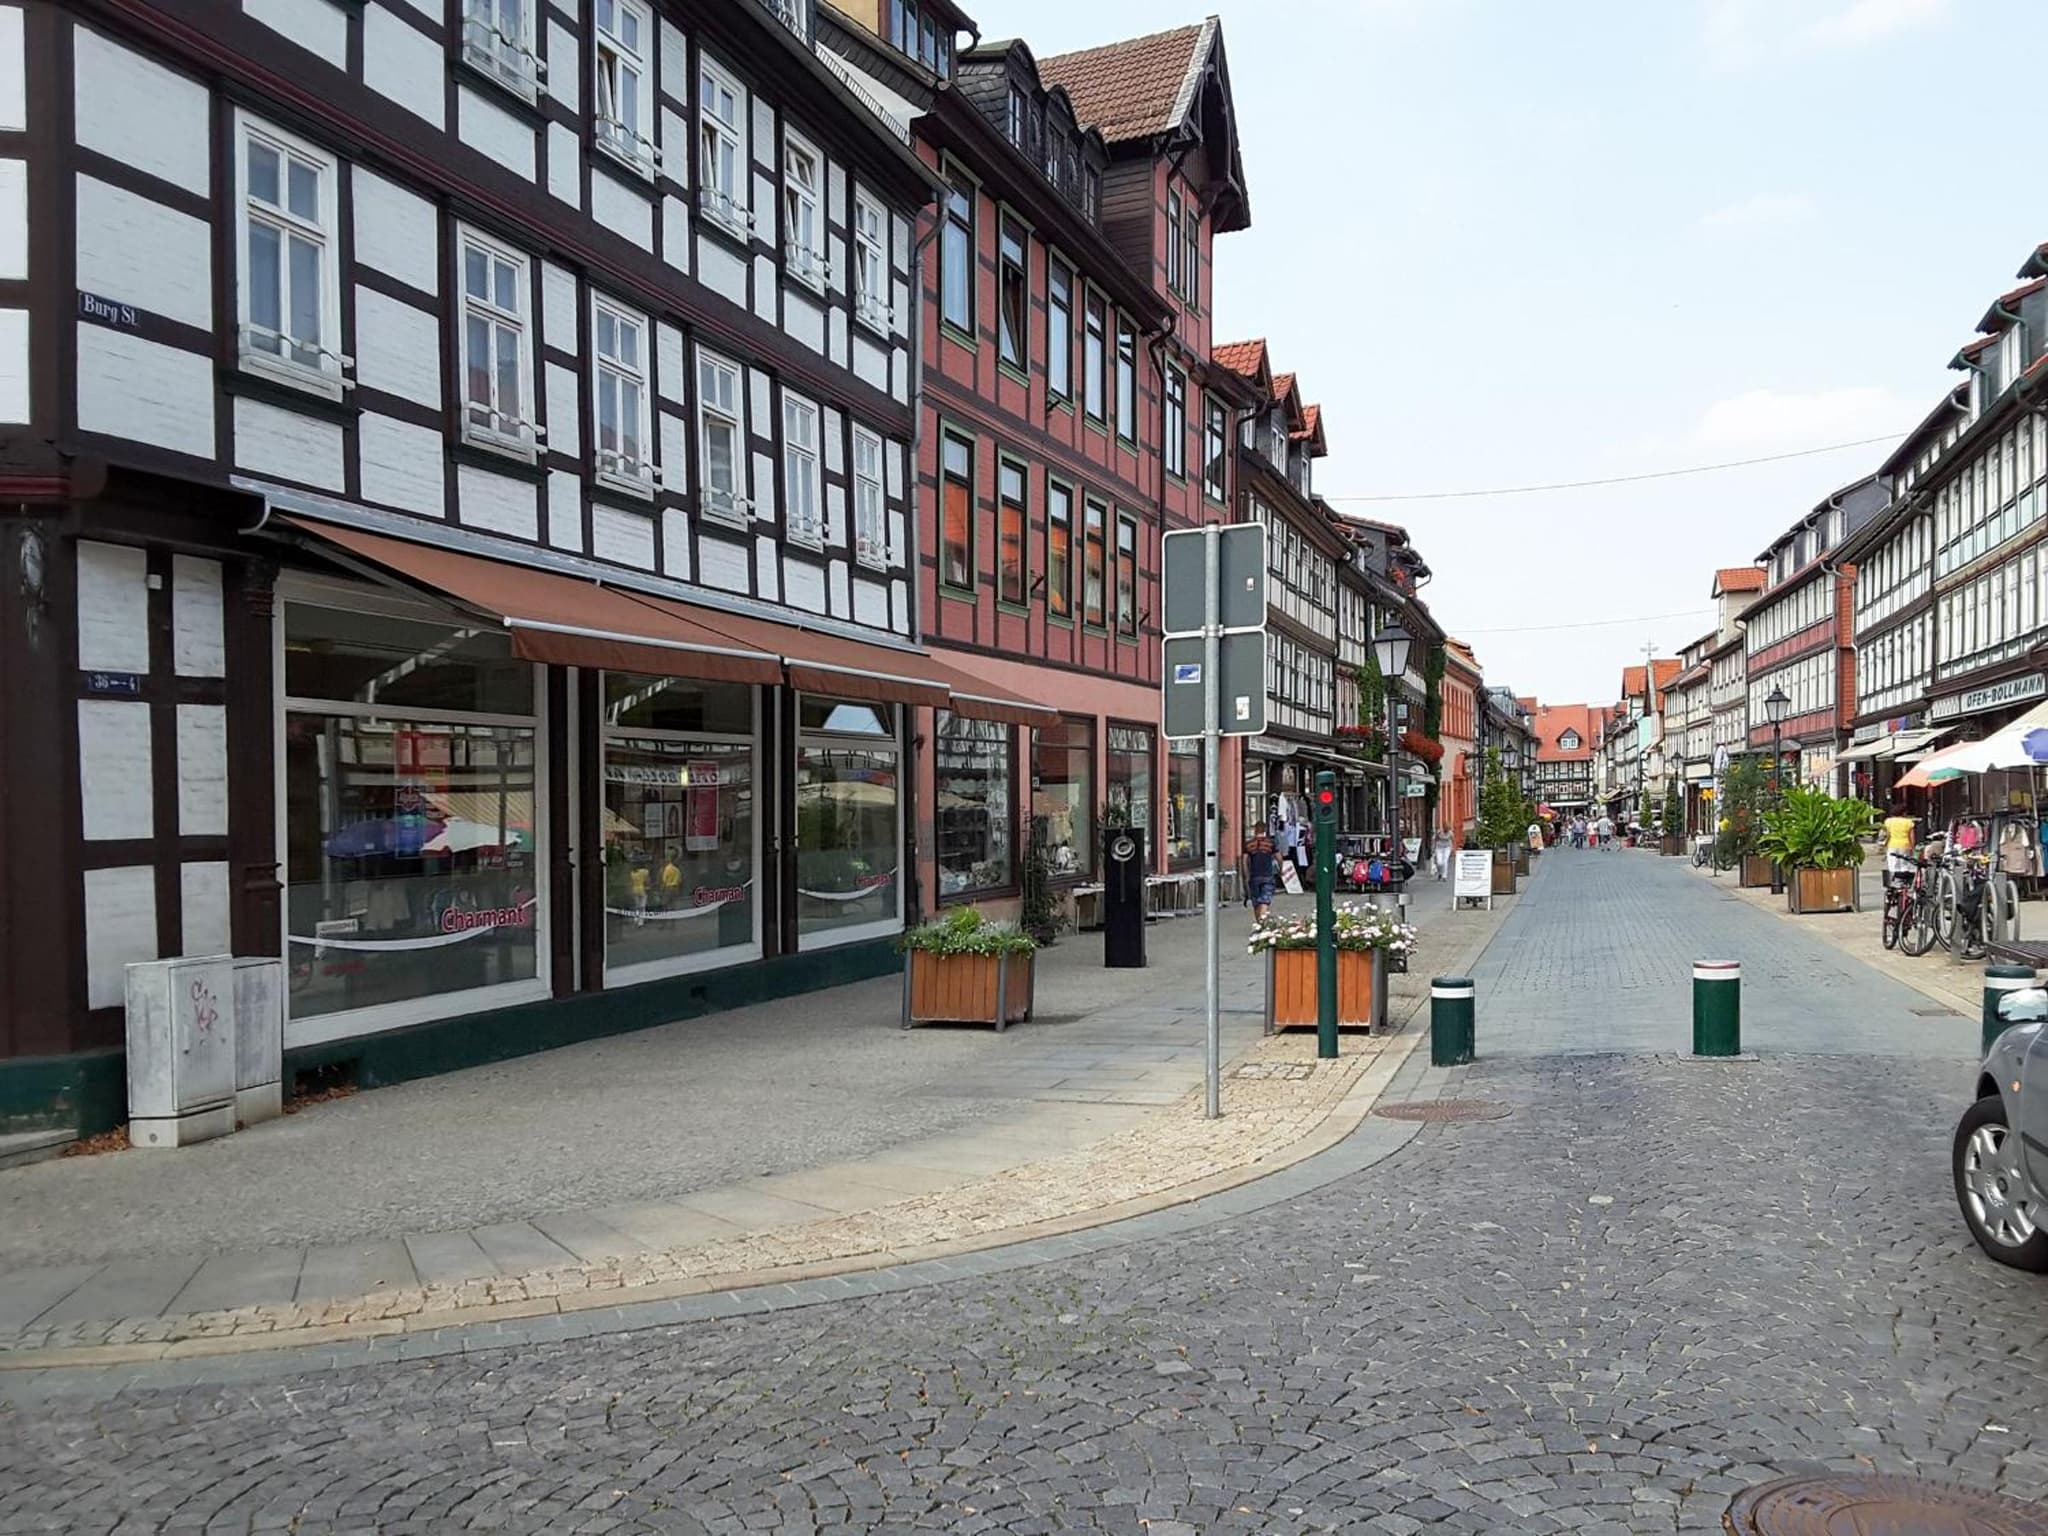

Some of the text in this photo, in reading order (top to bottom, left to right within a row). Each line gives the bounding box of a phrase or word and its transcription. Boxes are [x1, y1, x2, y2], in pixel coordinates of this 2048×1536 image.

[84, 294, 118, 324] Burg
[1967, 675, 2044, 708] OFEN-BOLLMANN
[441, 904, 526, 933] Charmant
